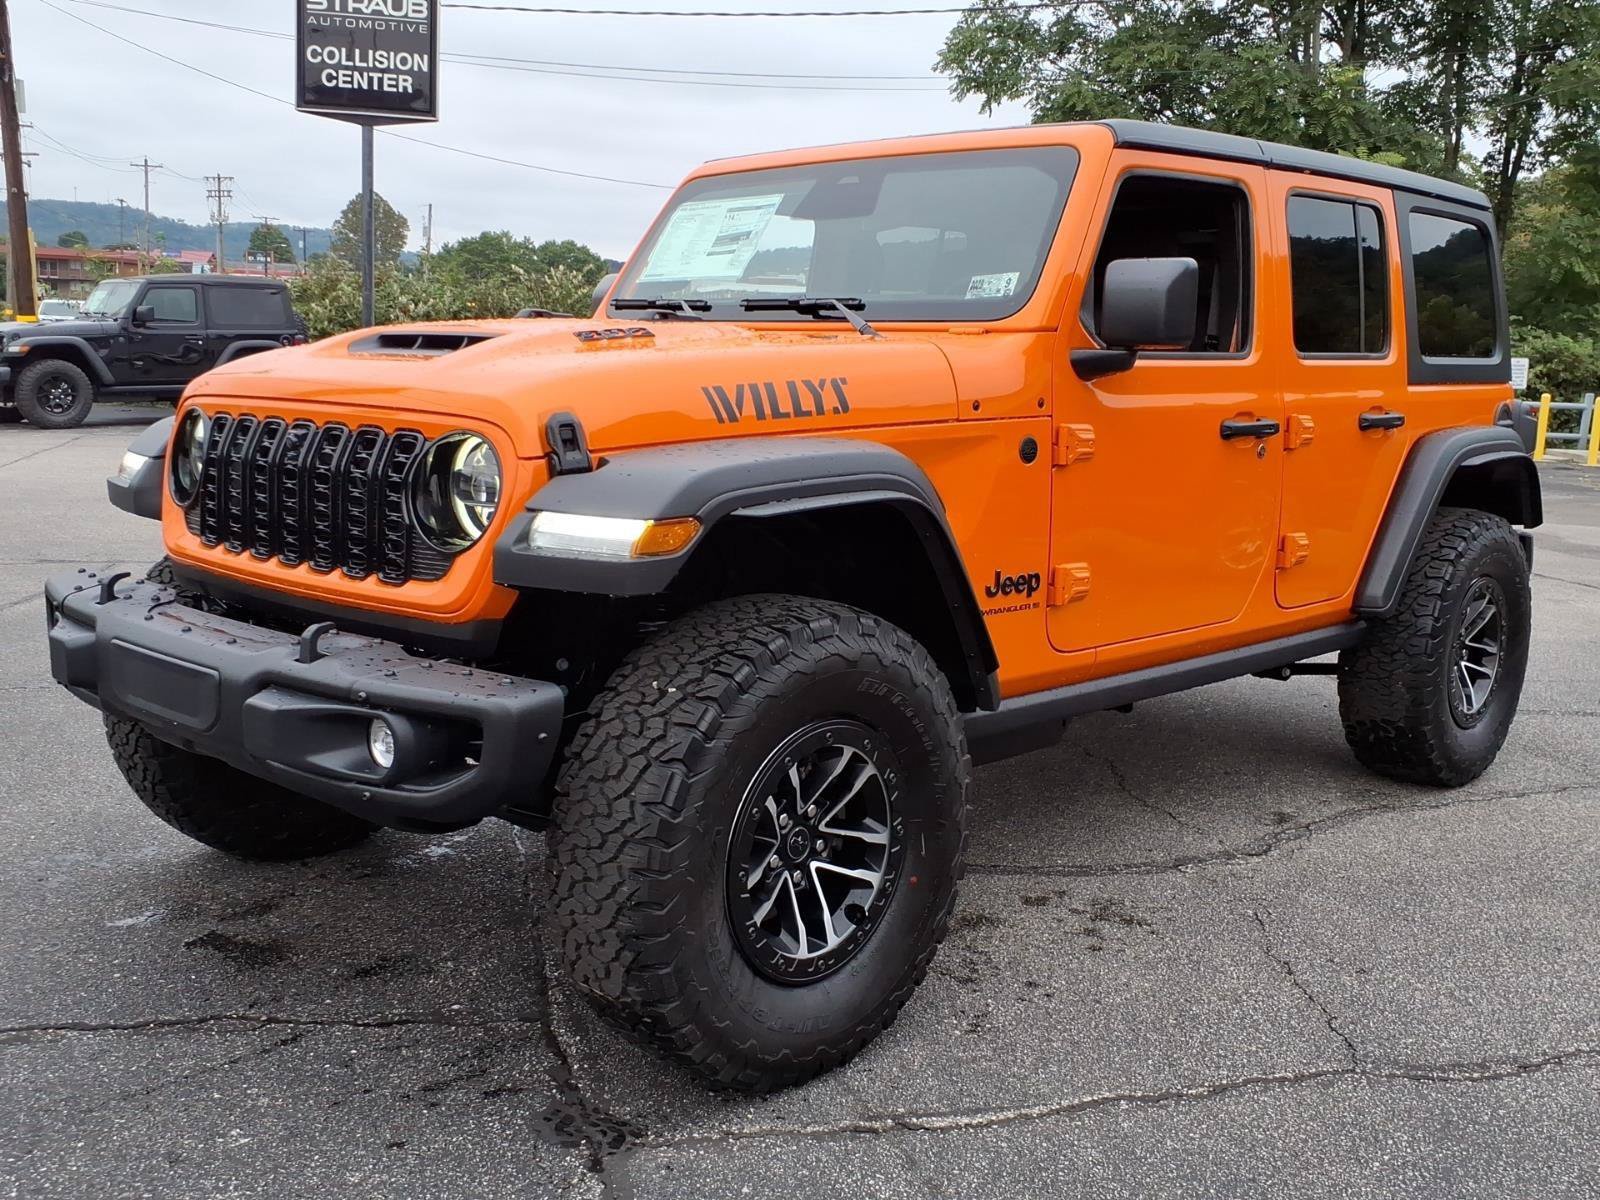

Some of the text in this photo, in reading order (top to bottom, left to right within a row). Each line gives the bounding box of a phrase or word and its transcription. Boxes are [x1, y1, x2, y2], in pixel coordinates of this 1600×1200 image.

[306, 0, 428, 18] STRAUB
[306, 16, 429, 34] AUTOMOTIVE
[306, 45, 429, 72] COLLISION
[321, 68, 413, 93] CENTER
[700, 377, 850, 425] WILLYS
[985, 568, 1041, 599] Jeep
[982, 603, 1032, 616] WRANGLER
